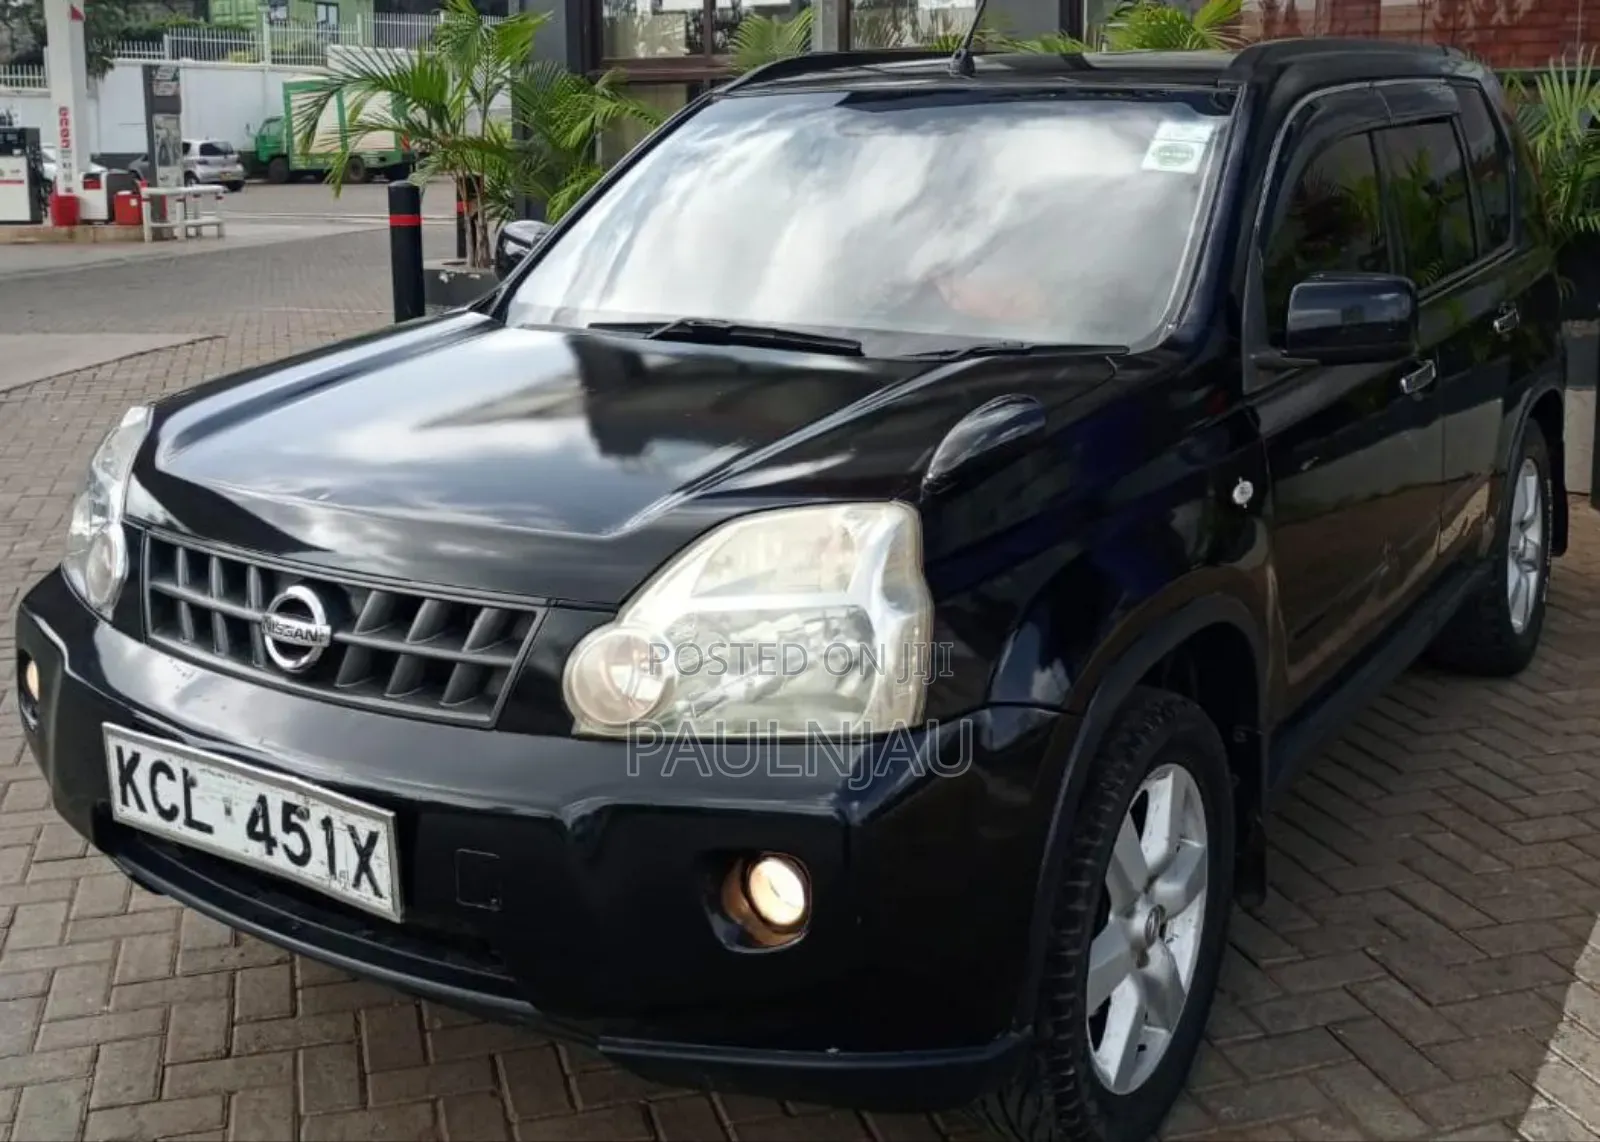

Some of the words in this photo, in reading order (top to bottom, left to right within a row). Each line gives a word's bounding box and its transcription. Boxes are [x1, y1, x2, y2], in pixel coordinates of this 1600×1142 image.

[262, 615, 319, 641] NISSAN
[115, 746, 214, 835] KCL
[246, 793, 384, 899] 451X
